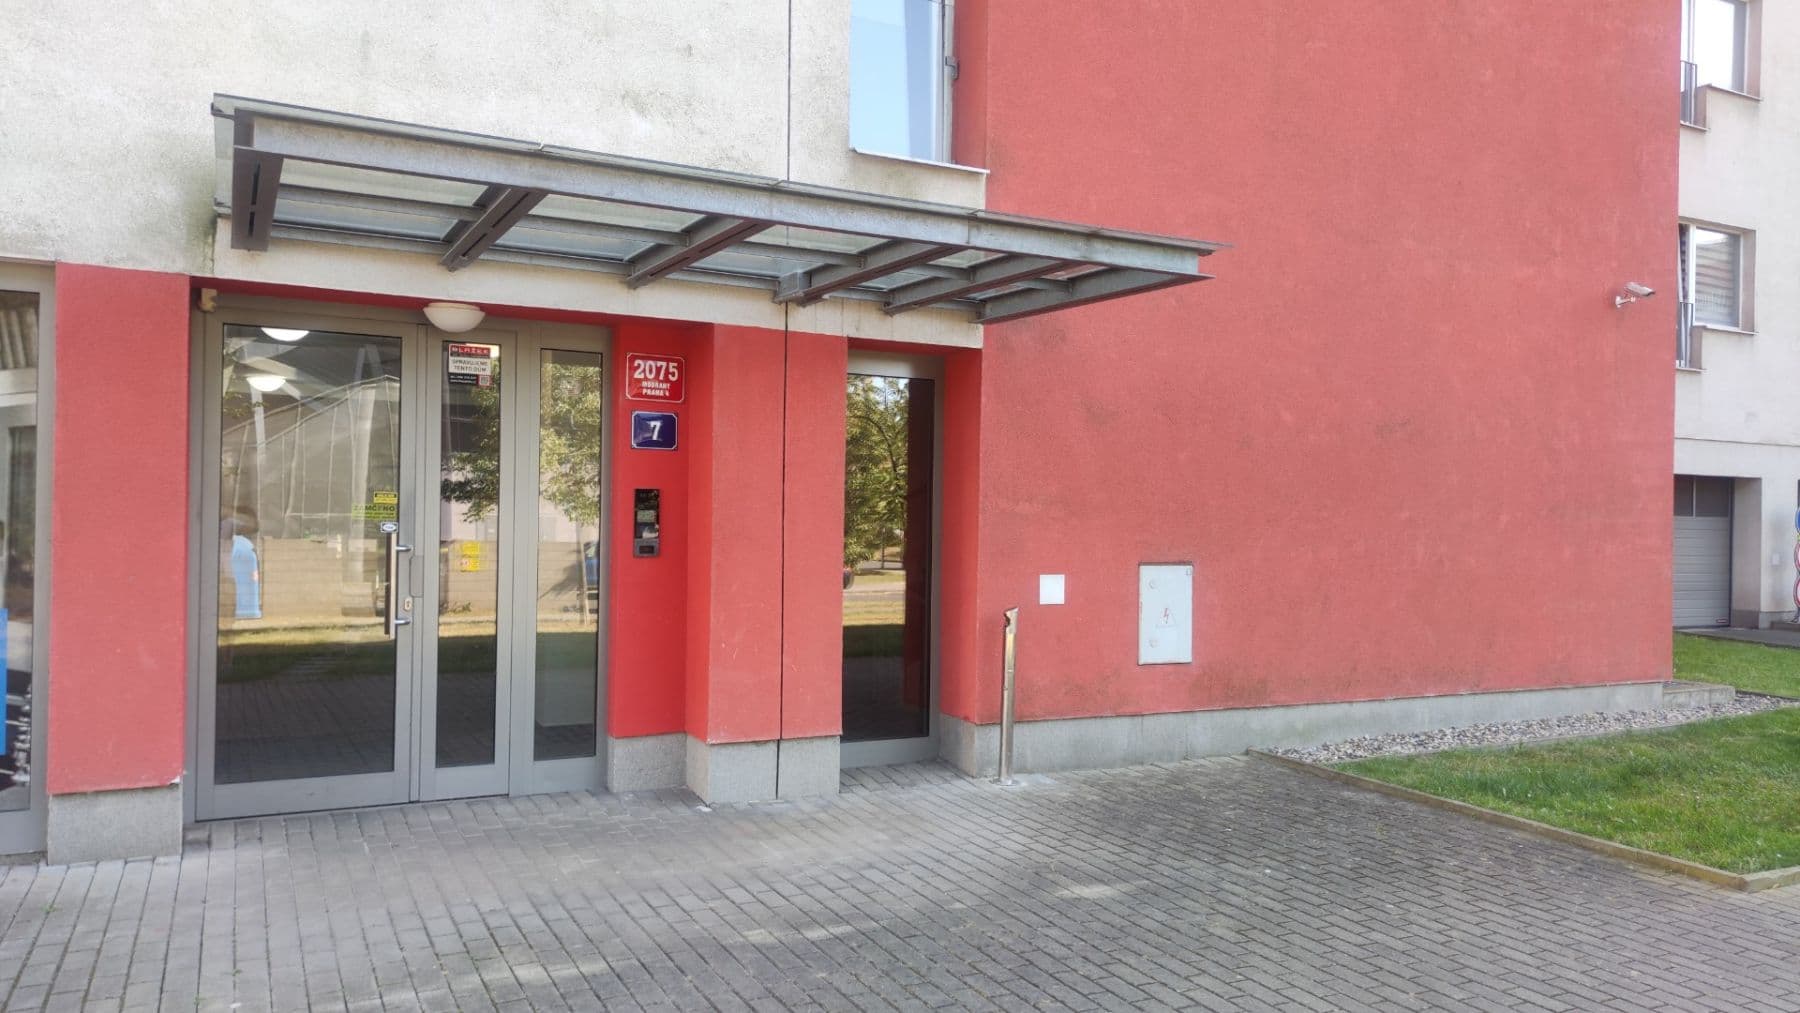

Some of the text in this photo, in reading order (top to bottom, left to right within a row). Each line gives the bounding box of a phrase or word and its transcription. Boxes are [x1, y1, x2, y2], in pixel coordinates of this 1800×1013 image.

[633, 359, 679, 382] 2075
[642, 388, 664, 396] PRAHA
[650, 421, 661, 440] 7
